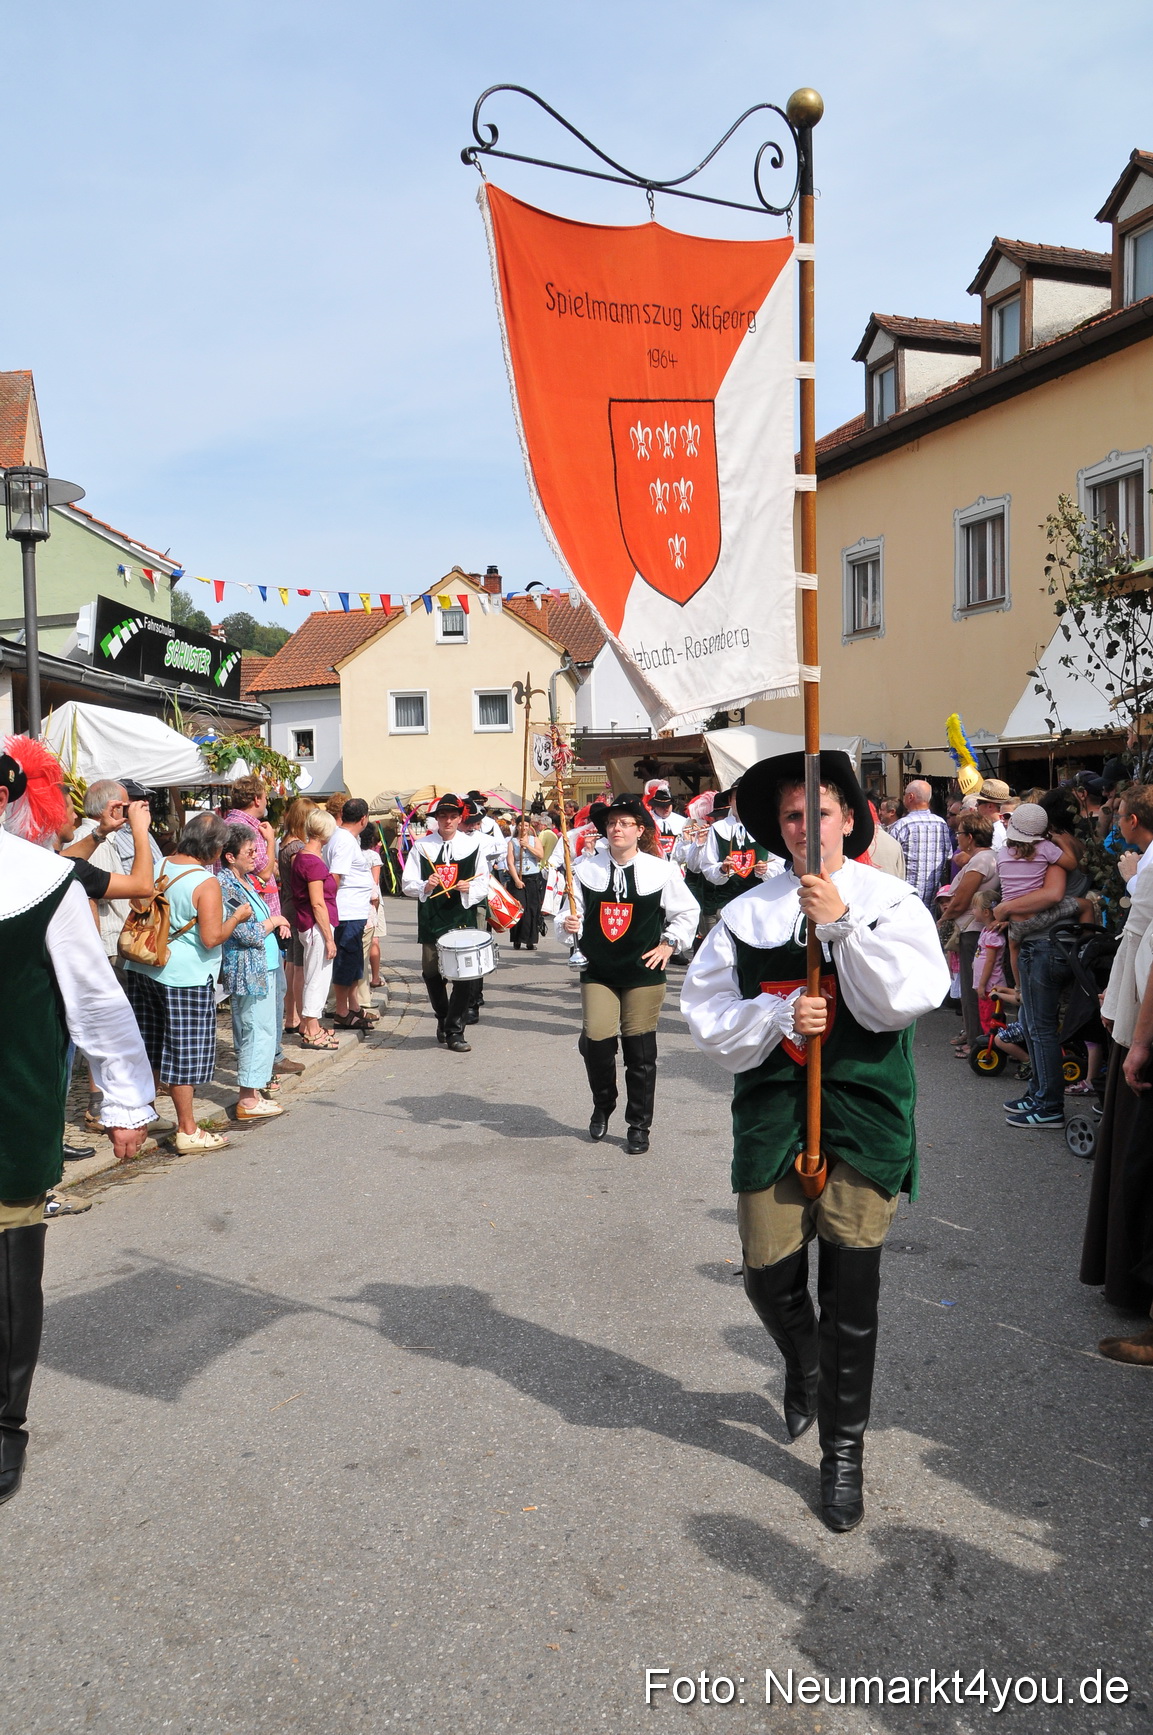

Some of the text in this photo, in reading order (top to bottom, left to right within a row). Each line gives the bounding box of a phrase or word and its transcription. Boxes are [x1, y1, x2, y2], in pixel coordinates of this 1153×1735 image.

[545, 282, 682, 331] Spielmannszug
[647, 348, 678, 368] 1964
[143, 616, 176, 638] Fahrschulen
[164, 639, 212, 677] SCHUSTER
[631, 627, 750, 671] lzbach-Rosenberg
